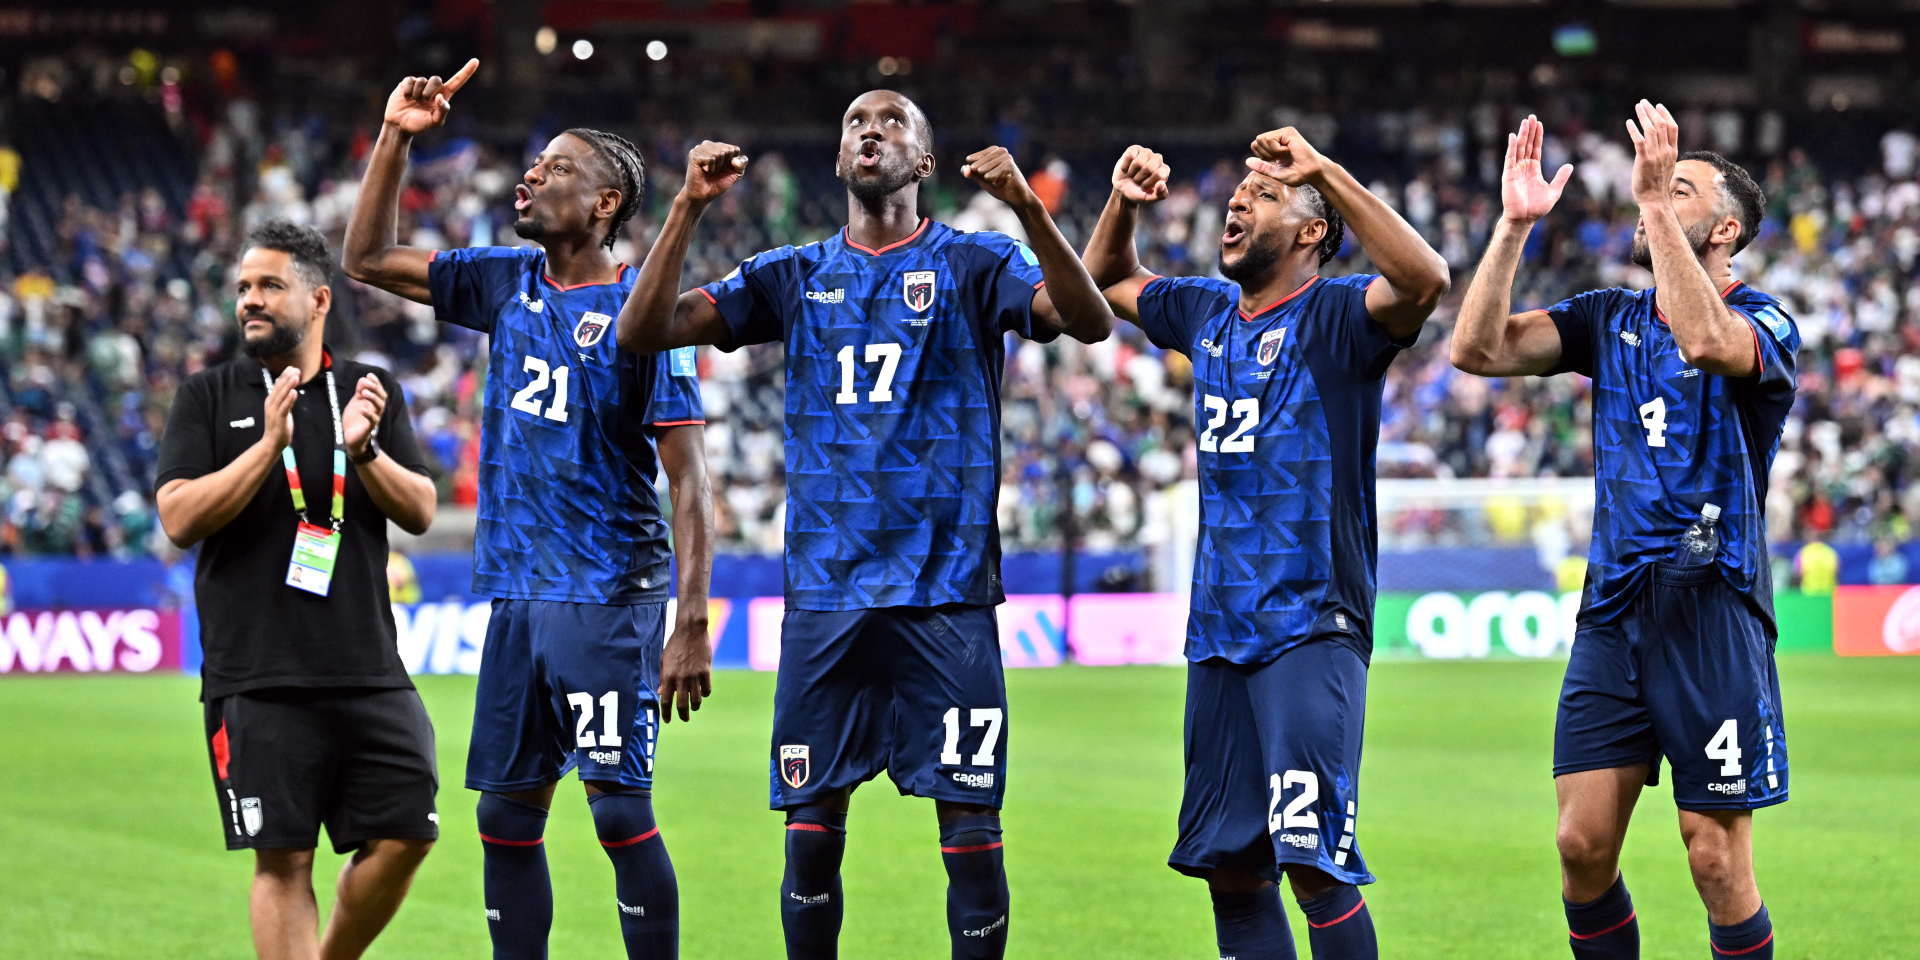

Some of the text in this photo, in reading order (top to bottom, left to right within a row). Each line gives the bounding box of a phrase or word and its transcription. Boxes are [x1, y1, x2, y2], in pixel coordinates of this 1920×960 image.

[805, 288, 845, 303] capelli
[906, 273, 932, 281] FCF
[510, 355, 568, 423] 21
[836, 342, 903, 405] 17
[1199, 393, 1260, 453] 22
[1639, 396, 1668, 448] 4
[0, 609, 163, 673] WAYS
[566, 690, 622, 748] 21
[940, 707, 1003, 767] 17
[588, 750, 621, 763] capelli
[783, 747, 806, 755] FCF
[1704, 719, 1742, 777] 4
[952, 772, 994, 786] capelli
[1268, 769, 1319, 836] 22
[1707, 778, 1747, 795] capelli
[1280, 833, 1319, 847] capelli
[1295, 842, 1318, 851] SPORT
